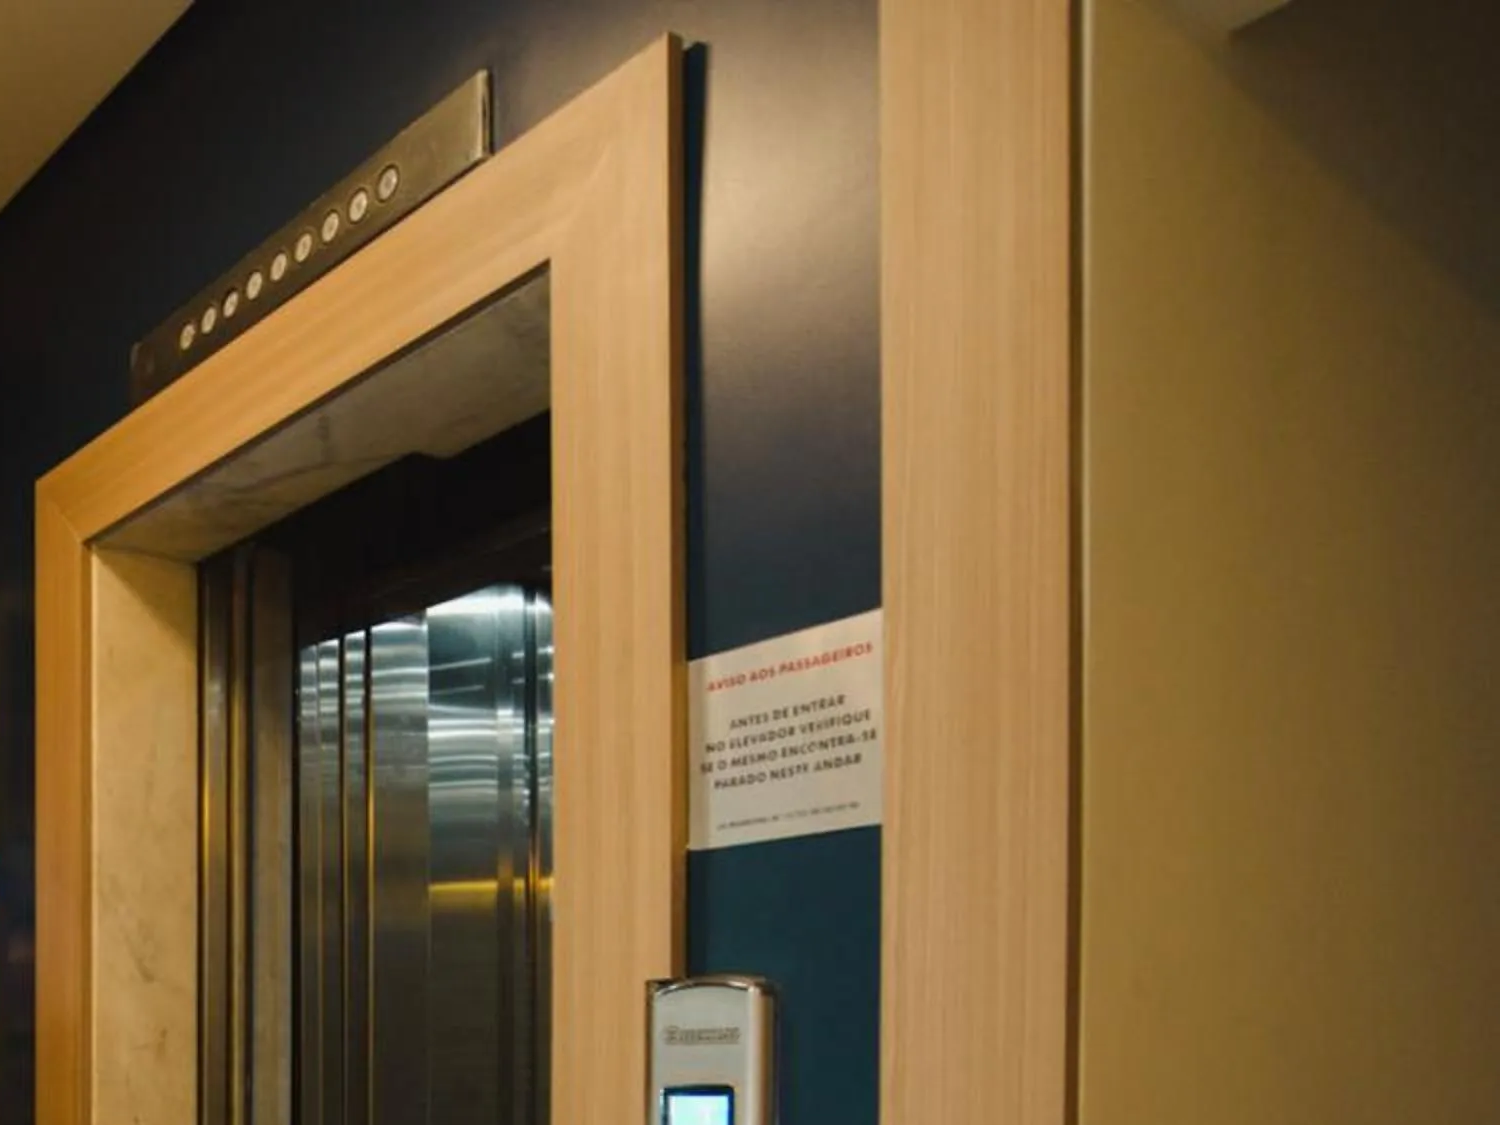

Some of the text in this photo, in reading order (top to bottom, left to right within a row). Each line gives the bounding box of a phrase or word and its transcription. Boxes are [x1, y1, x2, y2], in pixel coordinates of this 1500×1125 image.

[707, 641, 874, 692] AVISO AOS PASSAGEIROS
[705, 709, 872, 754] NO ELEVADOR VERIFIQUE
[730, 694, 846, 730] ANTES DE ENTRAR
[700, 728, 877, 774] SE O MESMO ENCONTRA-SE
[714, 752, 863, 790] PARADO NESTE ANDAR
